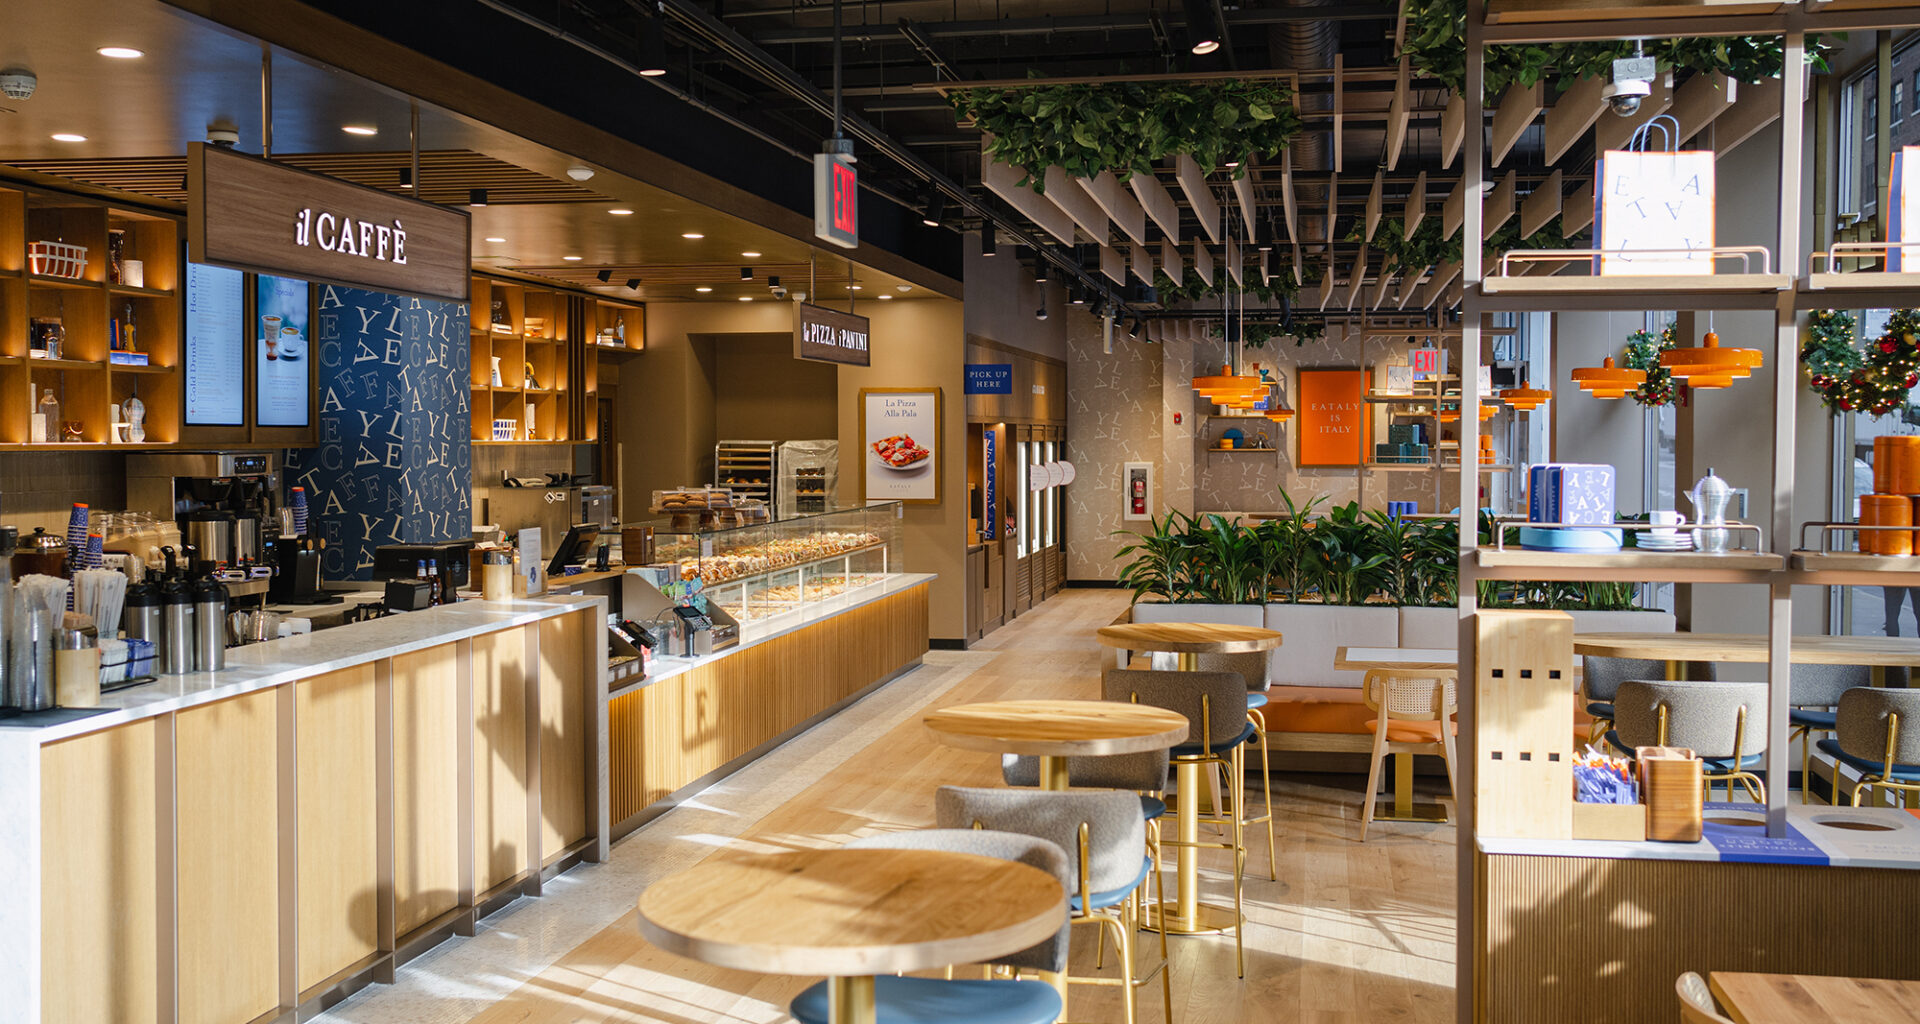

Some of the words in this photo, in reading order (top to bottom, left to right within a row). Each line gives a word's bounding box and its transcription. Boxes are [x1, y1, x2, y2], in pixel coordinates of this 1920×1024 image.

[833, 162, 855, 235] EXIT
[1681, 173, 1700, 196] A
[1625, 196, 1646, 219] T
[296, 208, 311, 246] il
[316, 212, 407, 265] CAFFÈ
[1617, 239, 1632, 262] L
[319, 285, 344, 310] A
[355, 305, 382, 335] Y
[385, 305, 404, 336] L
[426, 309, 439, 338] Y
[440, 313, 450, 342] L
[811, 323, 836, 346] PIZZA
[842, 329, 867, 351] PANINI
[320, 341, 342, 368] C
[353, 338, 380, 366] A
[382, 338, 402, 366] E
[439, 342, 448, 370] E
[1415, 351, 1438, 372] EXI
[398, 364, 412, 394] T
[446, 368, 458, 396] T
[320, 386, 346, 413] A
[411, 386, 423, 412] A
[457, 389, 469, 414] A
[885, 399, 895, 407] La
[897, 399, 916, 407] Pizza
[1311, 403, 1359, 411] EATALY
[357, 409, 384, 438] Y
[386, 410, 404, 440] L
[428, 410, 440, 438] Y
[441, 412, 450, 440] L
[1320, 425, 1351, 433] ITALY
[1330, 414, 1341, 422] IS
[321, 444, 342, 470] C
[354, 441, 380, 469] A
[382, 442, 402, 470] E
[440, 442, 449, 468] E
[298, 467, 324, 497] T
[398, 467, 413, 496] T
[446, 466, 458, 494] T
[322, 489, 348, 516] A
[412, 489, 424, 515] A
[458, 486, 469, 512] A
[1576, 495, 1589, 511] A
[358, 513, 384, 542] Y
[388, 514, 406, 544] L
[428, 510, 440, 538] Y
[442, 511, 452, 538] L
